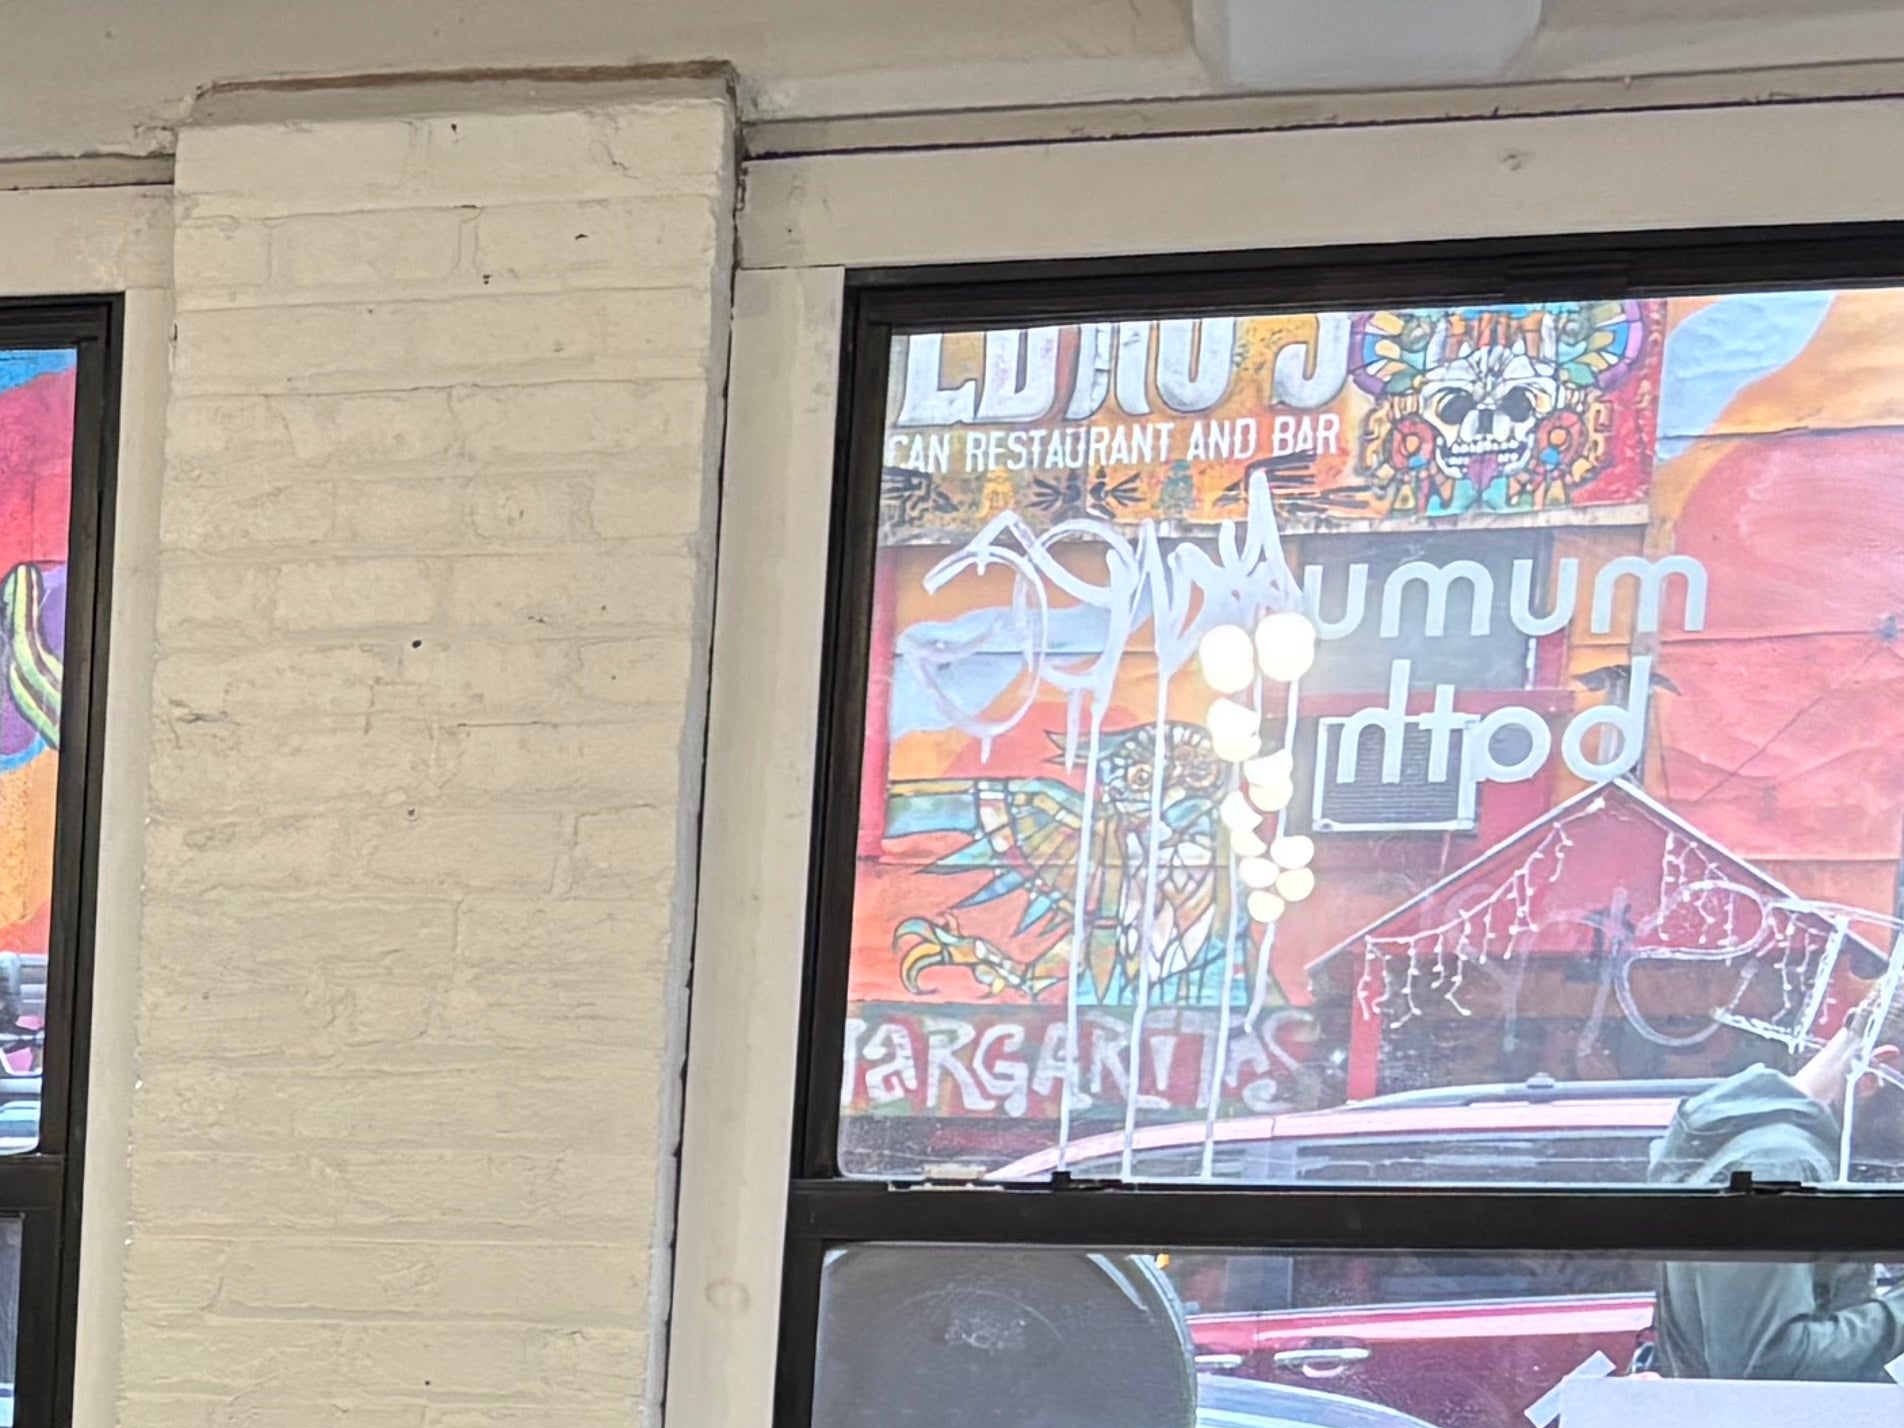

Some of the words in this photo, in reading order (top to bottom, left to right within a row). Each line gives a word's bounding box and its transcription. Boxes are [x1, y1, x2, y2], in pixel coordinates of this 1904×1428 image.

[965, 421, 1176, 472] RESTAURANT
[1188, 417, 1258, 461] AND
[1272, 413, 1341, 456] BAR
